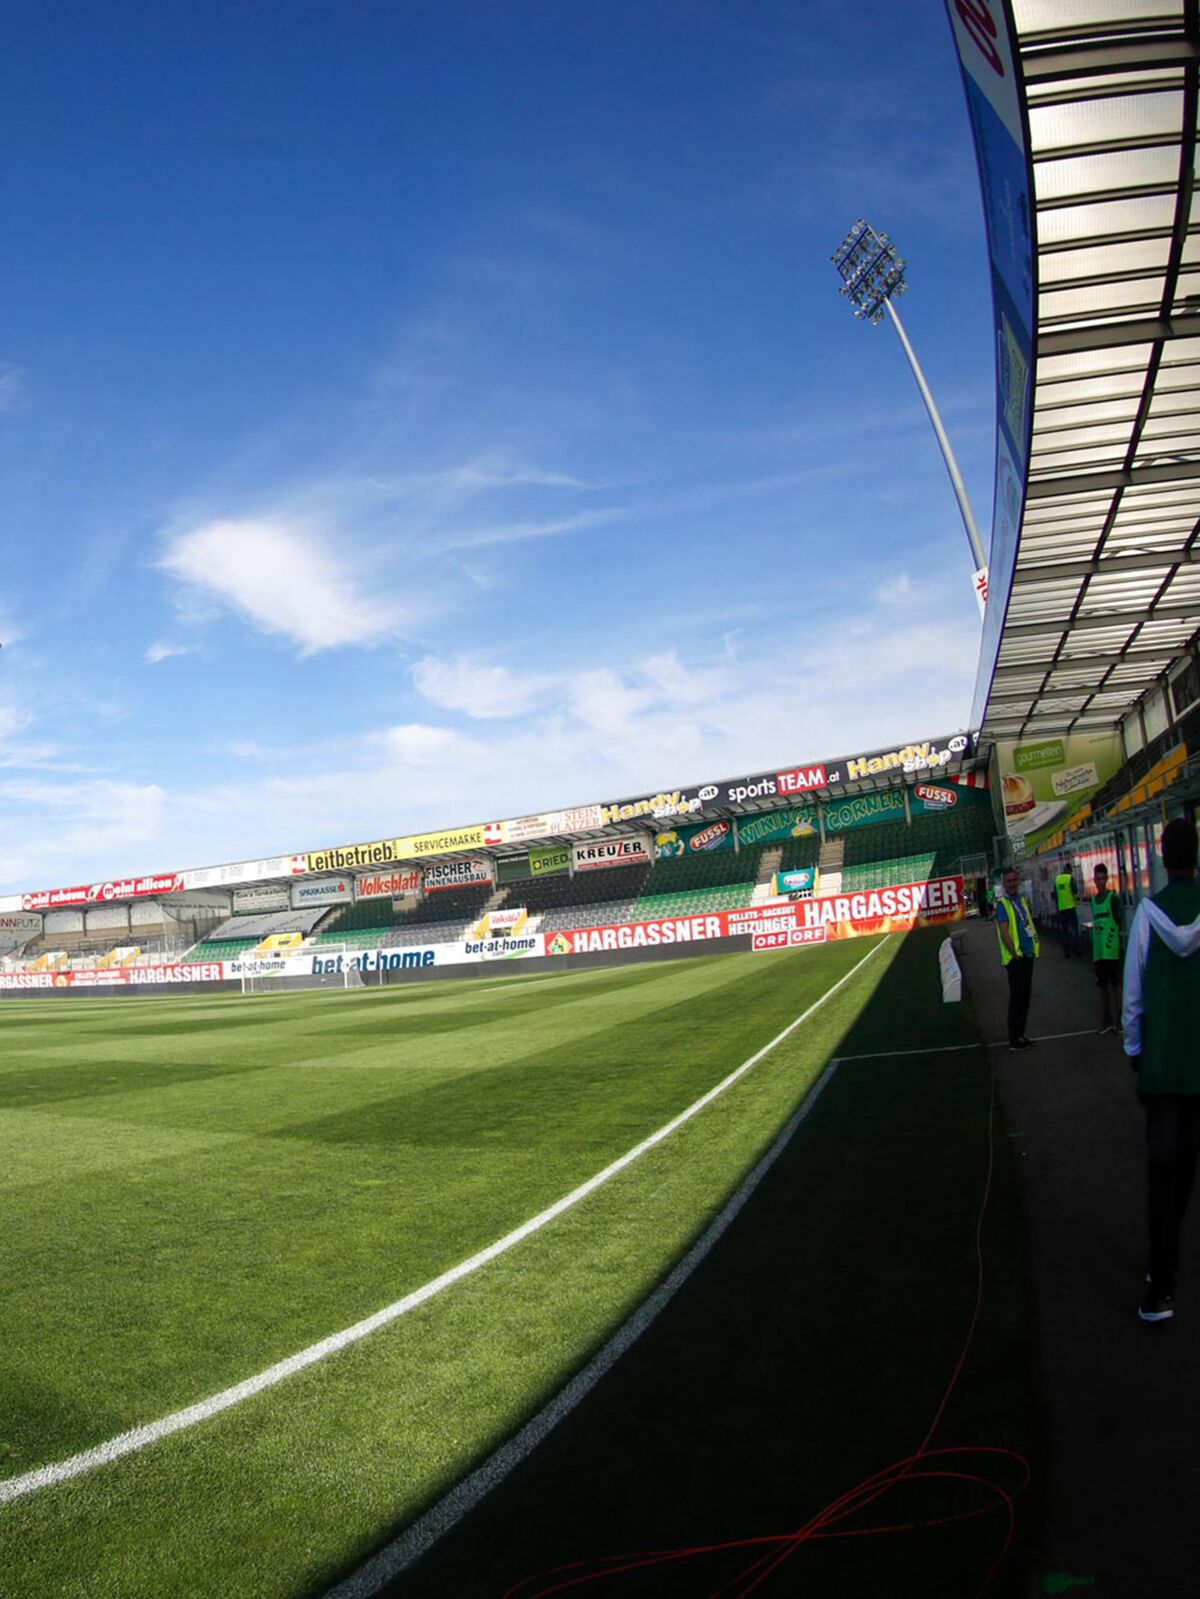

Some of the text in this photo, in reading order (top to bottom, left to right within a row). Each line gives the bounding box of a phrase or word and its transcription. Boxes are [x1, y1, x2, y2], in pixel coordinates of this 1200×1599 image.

[846, 742, 930, 780] Handy
[919, 787, 953, 804] FUSSL
[601, 790, 681, 825] Handy
[827, 790, 904, 830] CORNER
[414, 832, 481, 852] SERVICEMARKE
[694, 824, 727, 848] FUSSL
[542, 853, 568, 868] RIED
[577, 842, 642, 861] KREUZER
[426, 862, 471, 879] FISCHER
[426, 872, 486, 887] INNENAUSBAU
[136, 878, 172, 892] silicon
[299, 885, 337, 897] SPARKASSE
[359, 871, 419, 896] Volksblatt
[803, 880, 958, 927] HARGASSNER
[573, 916, 721, 952] HARGASSNER
[728, 916, 797, 936] HEIZUNGEN
[792, 928, 824, 943] ORF
[465, 938, 536, 954] bet-at-home
[755, 932, 786, 948] ORF
[129, 964, 221, 985] HARGASSNER
